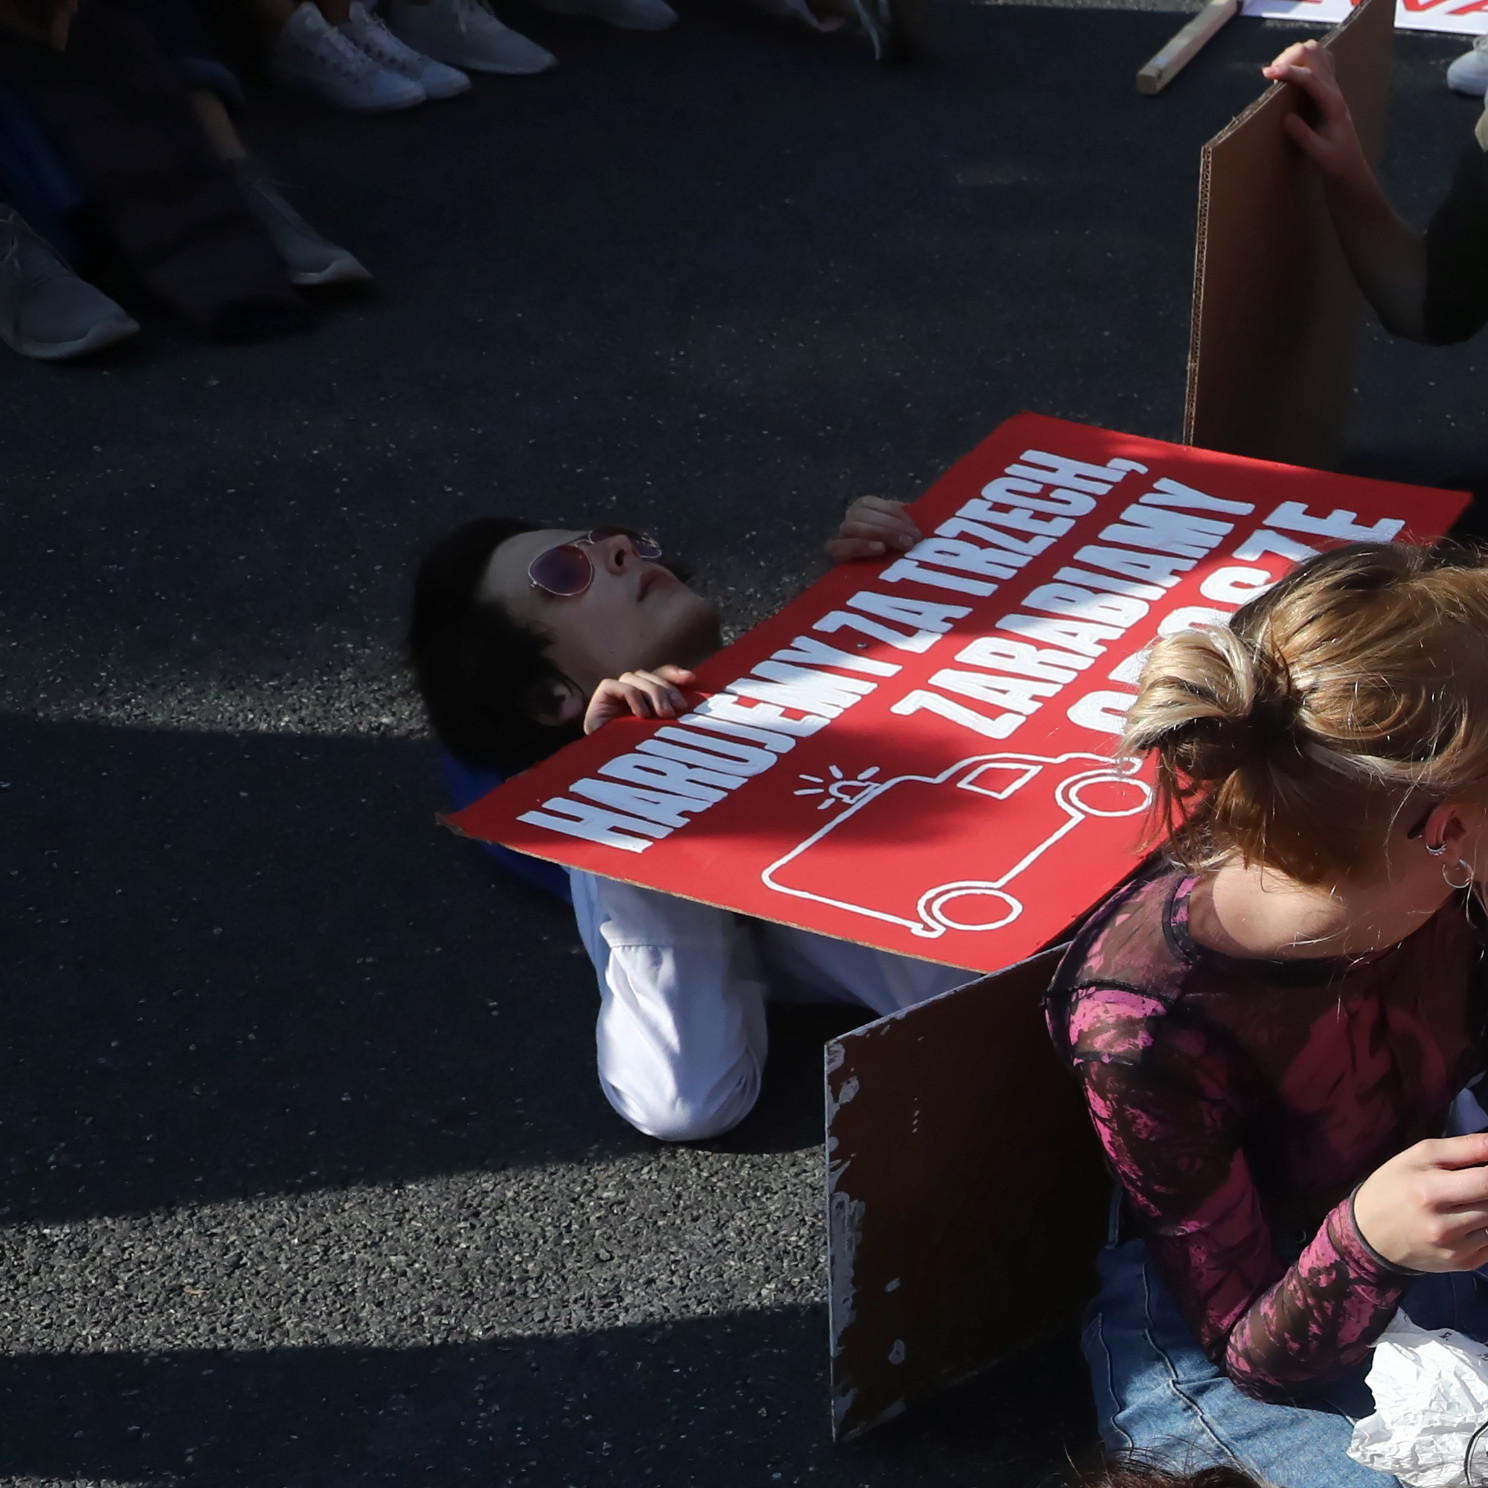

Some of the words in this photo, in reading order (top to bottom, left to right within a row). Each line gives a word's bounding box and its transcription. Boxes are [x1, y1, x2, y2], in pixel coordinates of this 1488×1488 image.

[891, 477, 1256, 740] ZARABIAMY
[892, 449, 1149, 599] TRZECH,
[842, 589, 968, 652] ZA
[516, 634, 904, 853] HARUJEMY
